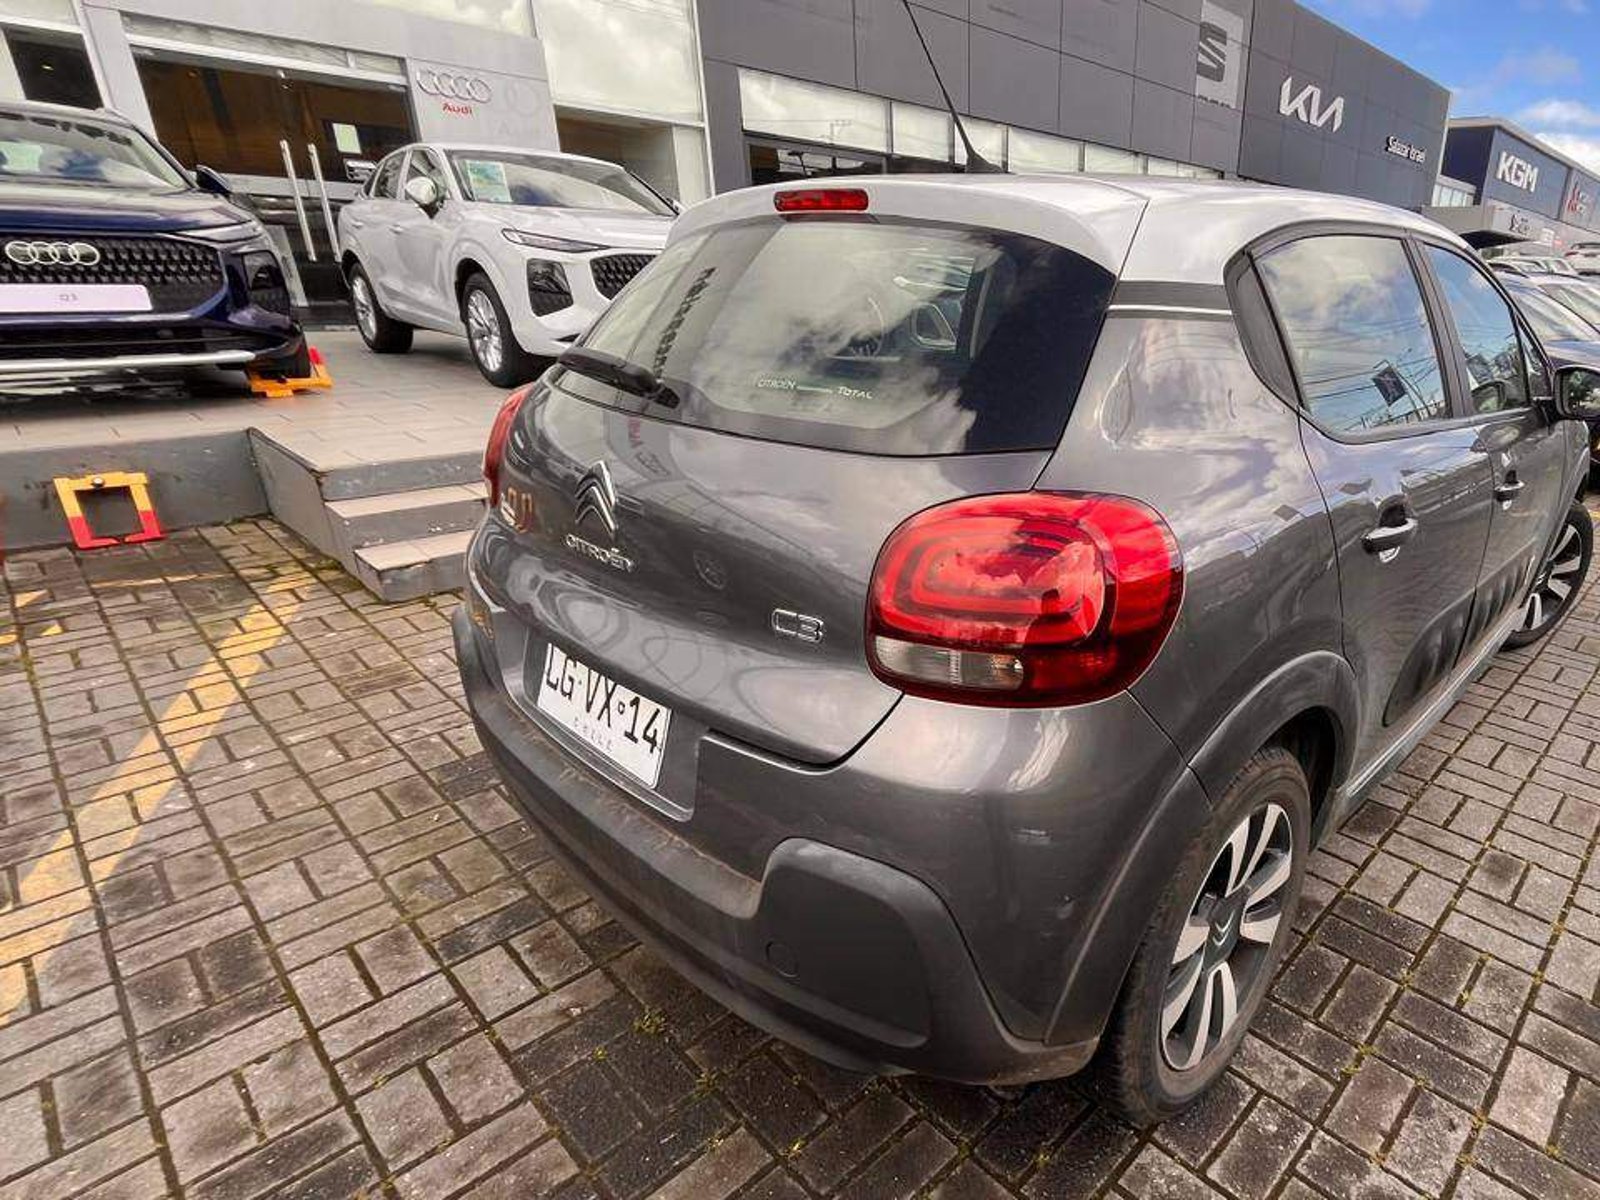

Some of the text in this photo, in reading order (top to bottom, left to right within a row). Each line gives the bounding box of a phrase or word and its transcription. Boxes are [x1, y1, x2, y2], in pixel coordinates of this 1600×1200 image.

[442, 103, 473, 115] Audi
[1279, 76, 1344, 133] KIA
[1496, 151, 1539, 193] KGM
[837, 385, 873, 400] TOTAL
[771, 608, 824, 643] C3
